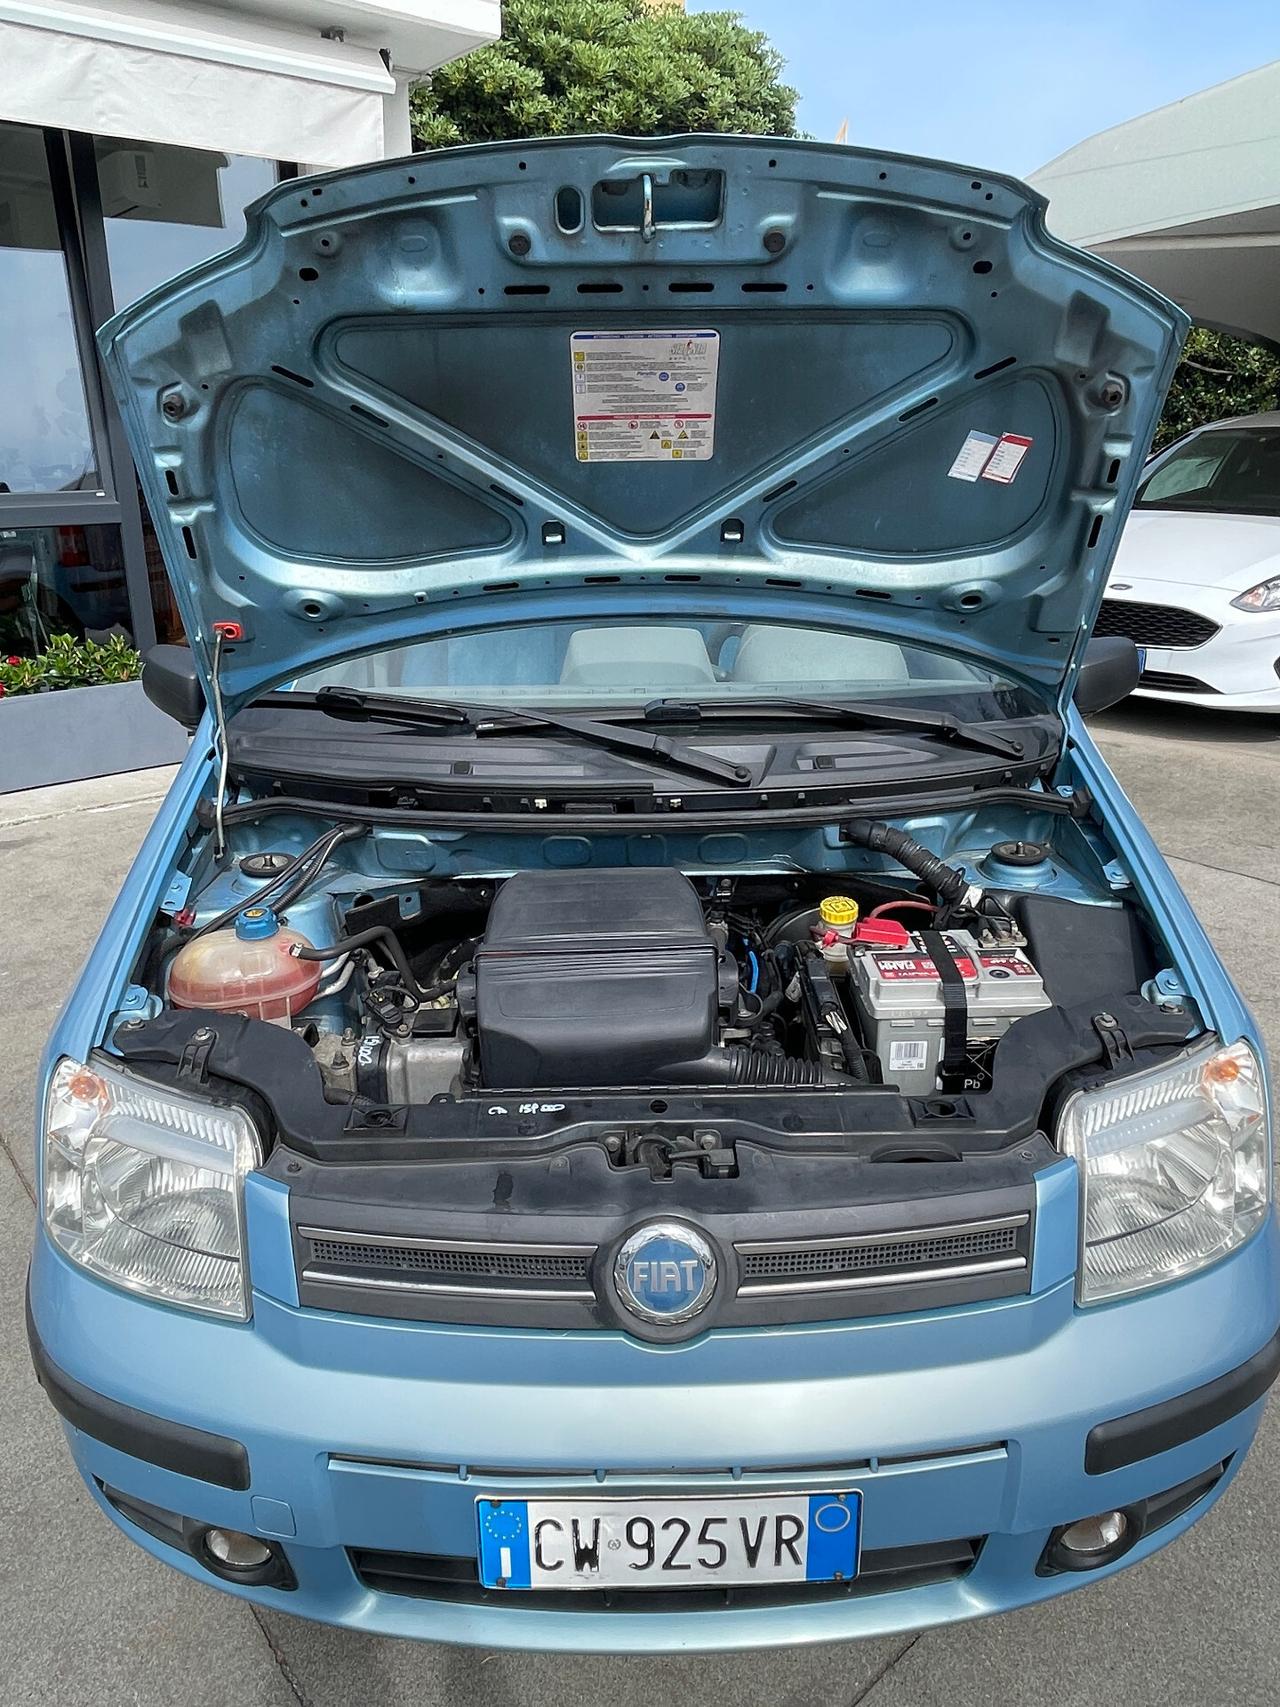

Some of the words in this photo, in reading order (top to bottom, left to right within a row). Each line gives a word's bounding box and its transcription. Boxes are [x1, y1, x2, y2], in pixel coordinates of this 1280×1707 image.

[964, 1079, 981, 1089] Pb
[633, 1260, 699, 1293] FIAT
[534, 1517, 601, 1573] CW
[625, 1514, 806, 1571] 925VR
